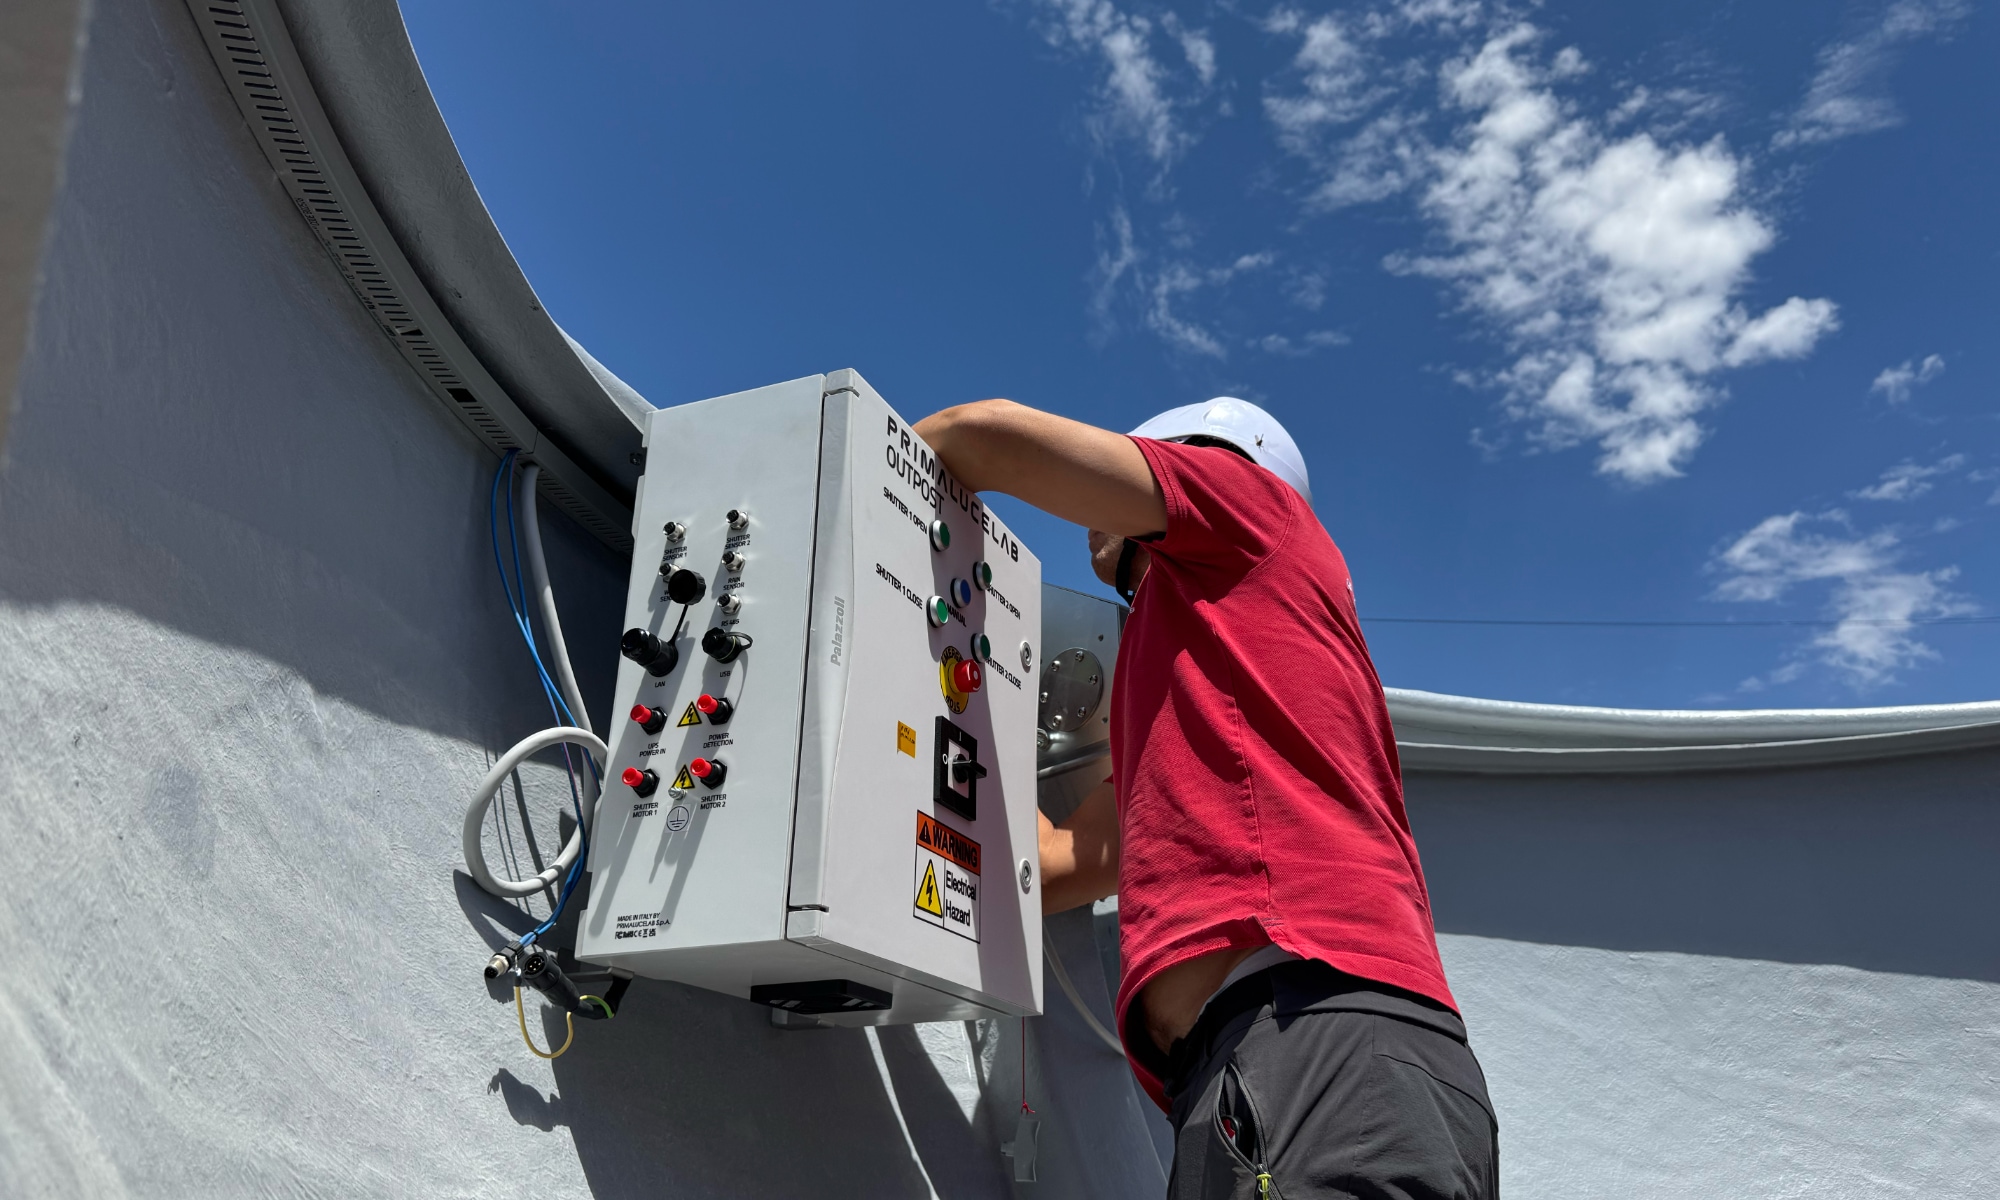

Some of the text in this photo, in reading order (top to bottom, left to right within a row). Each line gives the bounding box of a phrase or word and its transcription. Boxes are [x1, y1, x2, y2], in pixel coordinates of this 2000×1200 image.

[886, 444, 945, 515] OUTPOST
[887, 414, 1019, 563] PRIMALUCELAB
[883, 486, 927, 535] SHUTTER 1 OPEN
[727, 534, 750, 543] SHUTTER
[725, 541, 745, 549] SENSOR
[664, 546, 687, 555] SHUTTER
[663, 553, 683, 561] SENSOR
[723, 582, 744, 590] SENSOR
[876, 563, 923, 610] SHUTTER 1 CLOSE
[1006, 600, 1009, 609] 2
[1009, 604, 1020, 620] OPEN
[947, 603, 966, 627] MANUAL
[1005, 670, 1008, 679] 2
[1008, 673, 1021, 690] CLOSE
[946, 695, 960, 712] STOP
[708, 733, 729, 741] POWER
[703, 739, 734, 748] DETECTION
[701, 794, 726, 803] SHUTTER
[633, 802, 658, 811] SHUTTER
[700, 802, 721, 810] MOTOR
[632, 810, 653, 818] MOTOR
[933, 825, 977, 868] WARNING
[946, 870, 976, 900] Electrical
[945, 899, 970, 926] Hazard
[616, 920, 655, 929] PRIMALUCELAB
